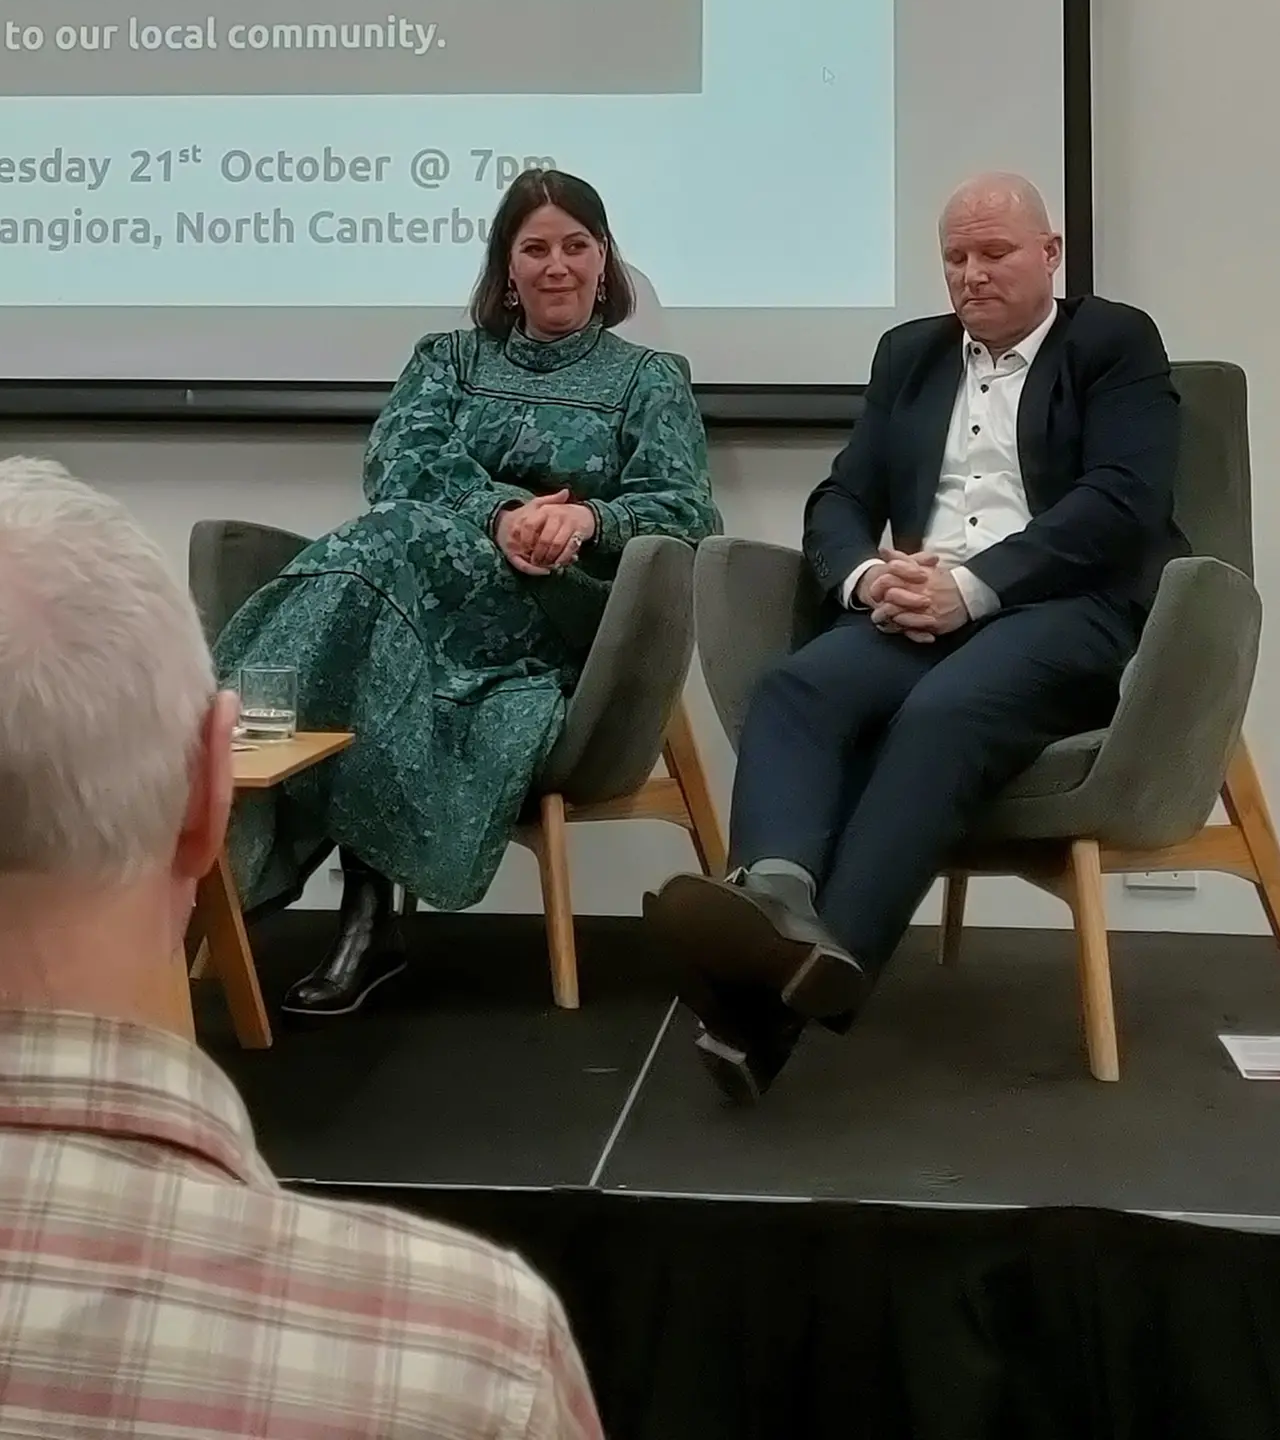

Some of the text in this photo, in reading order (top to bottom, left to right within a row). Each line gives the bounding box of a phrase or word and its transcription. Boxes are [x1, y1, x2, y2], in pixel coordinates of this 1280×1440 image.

[6, 14, 446, 55] to our local community.
[130, 144, 202, 183] 21st
[221, 146, 391, 183] October
[410, 148, 450, 189] @
[176, 207, 295, 244] North
[308, 206, 489, 244] Canterb
